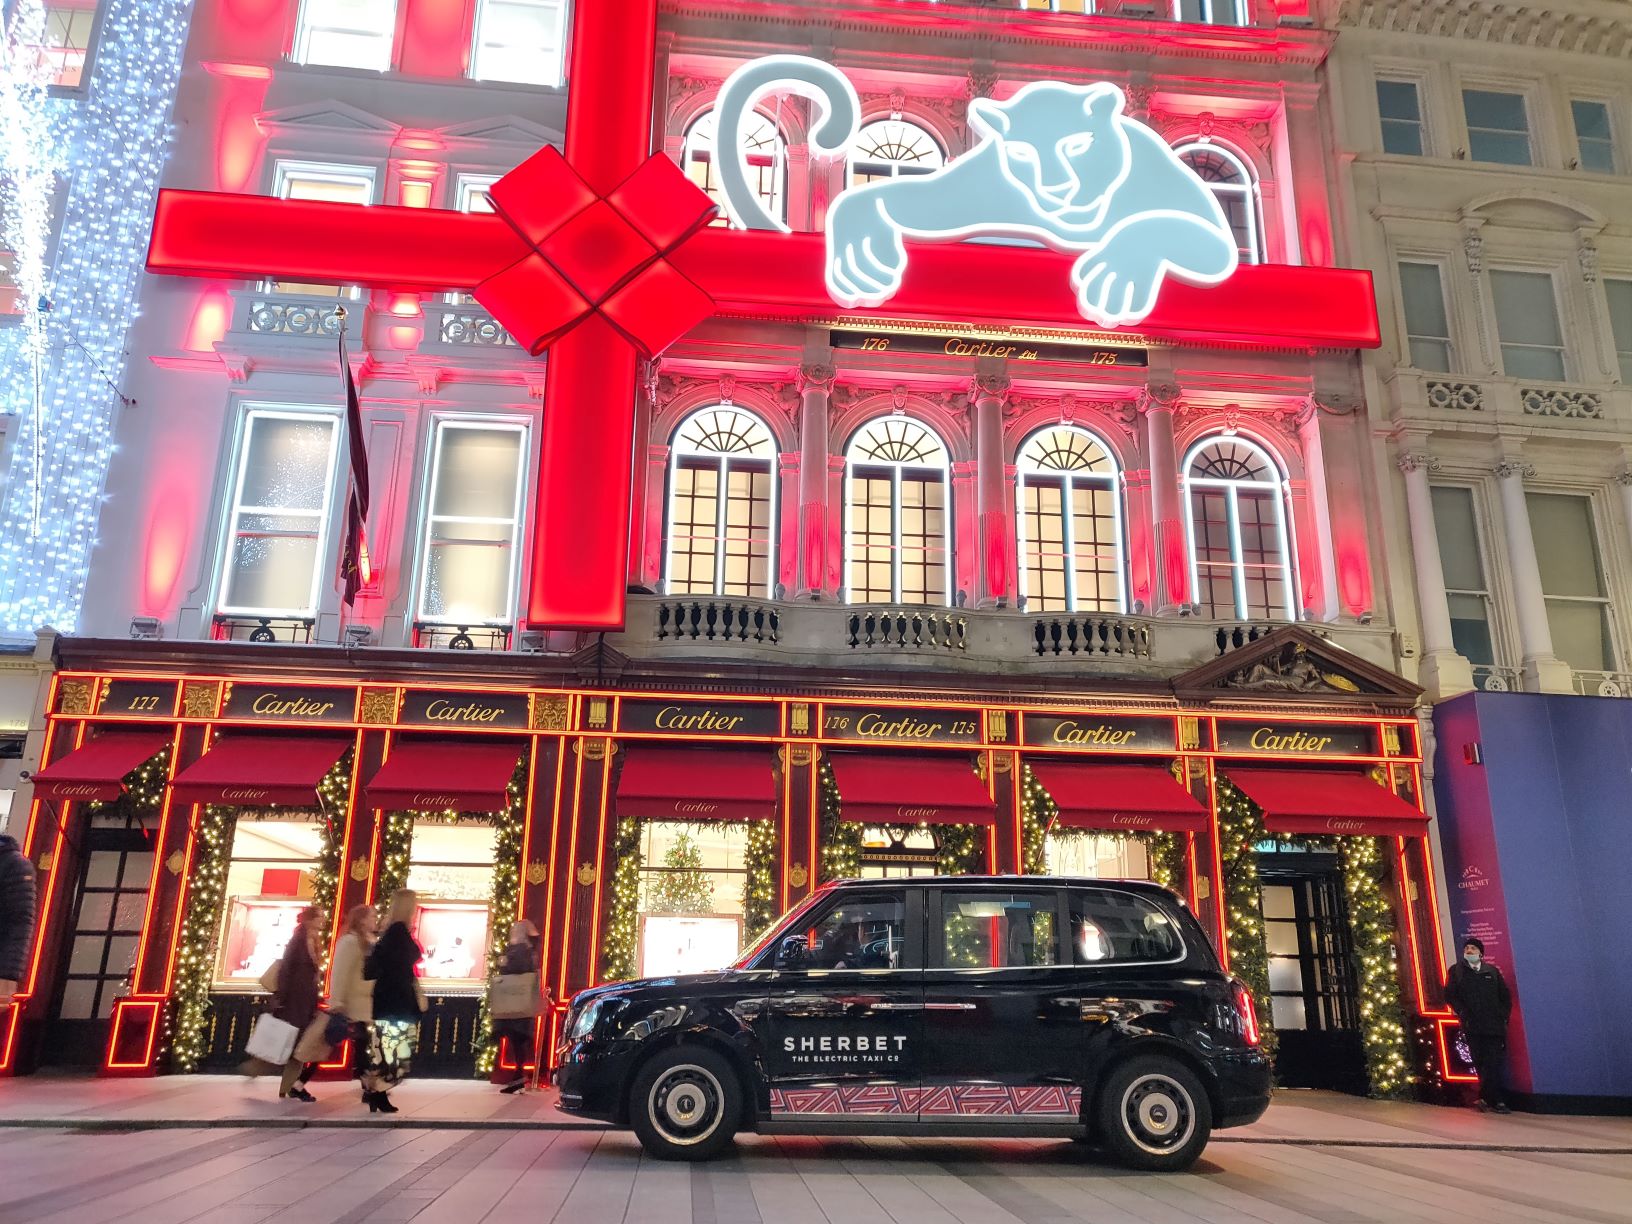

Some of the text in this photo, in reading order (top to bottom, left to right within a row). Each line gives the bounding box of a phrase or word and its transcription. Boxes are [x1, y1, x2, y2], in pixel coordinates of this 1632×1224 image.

[860, 337, 1118, 365] 176 Cartier Ltd 175
[128, 696, 160, 710] 177
[252, 693, 334, 716] Cartier
[425, 699, 505, 722] Cartier
[655, 706, 744, 731] Cartier
[824, 713, 976, 738] 176 Cartier 175
[1053, 721, 1137, 745] Cartier
[1251, 727, 1331, 751] Cartier
[52, 782, 101, 796] Cartier
[221, 787, 268, 799] Cartier
[413, 793, 459, 806] Cartier
[674, 800, 718, 813] Cartier
[897, 805, 940, 817] Cartier
[1112, 812, 1153, 826] Cartier
[1326, 817, 1366, 830] Cartier
[1458, 879, 1490, 889] CHAUMET
[784, 1036, 907, 1051] SHERBET
